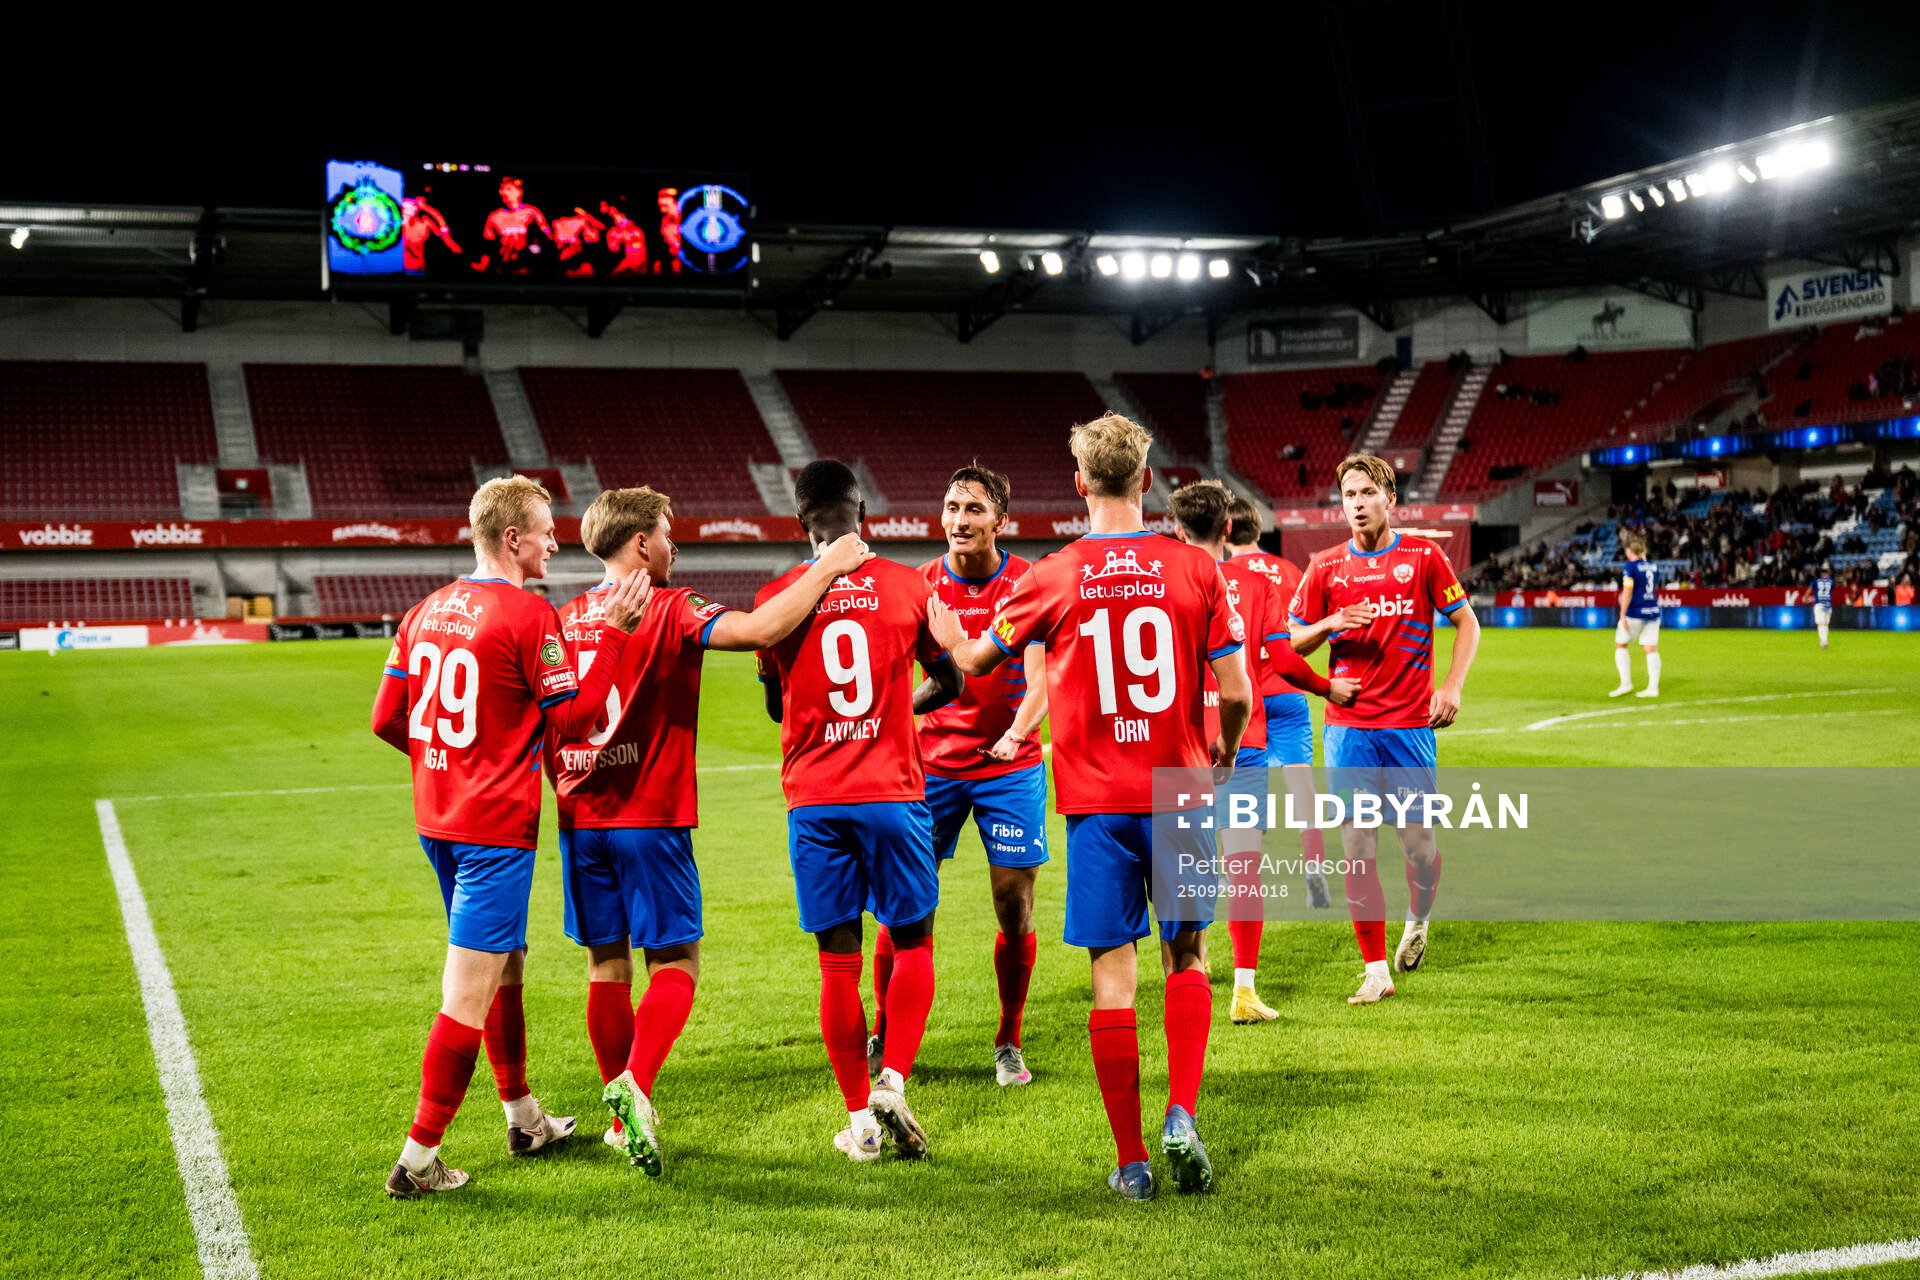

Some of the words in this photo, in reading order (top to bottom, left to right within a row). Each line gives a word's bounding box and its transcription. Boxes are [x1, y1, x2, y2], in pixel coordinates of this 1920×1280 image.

[1802, 270, 1884, 300] SVENSK
[19, 525, 94, 545] vobbiz
[131, 524, 203, 544] vobbiz
[868, 517, 929, 537] vobbiz
[1080, 583, 1165, 600] letusplay
[816, 594, 879, 614] tusplay
[548, 649, 558, 660] S
[1079, 606, 1177, 715] 19
[821, 619, 873, 718] 9
[542, 671, 576, 687] UNIBET
[408, 641, 479, 749] 29
[1114, 717, 1150, 743] ÖRN
[992, 824, 1024, 838] Fibio
[996, 843, 1026, 853] Resurs
